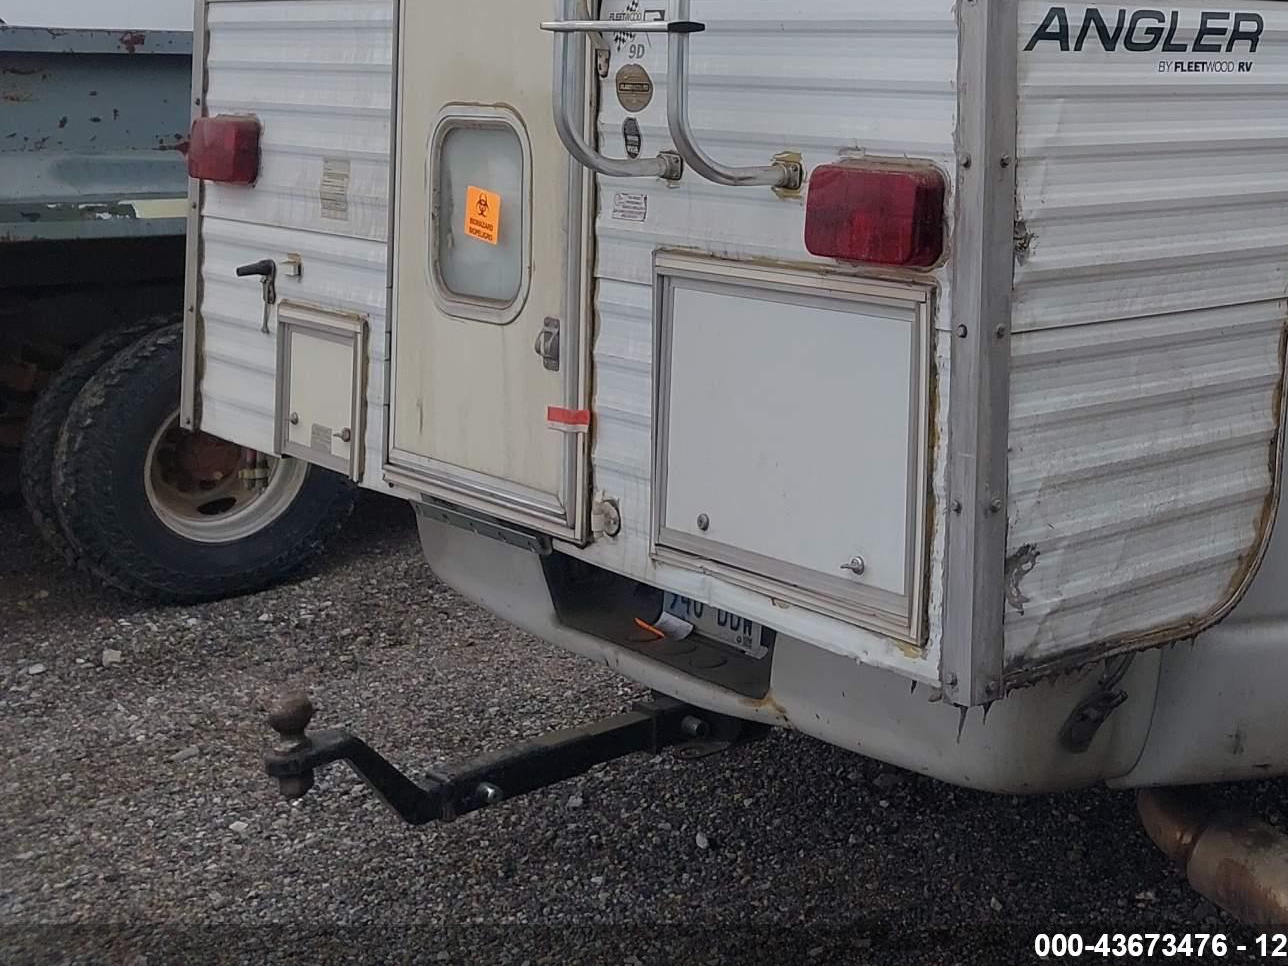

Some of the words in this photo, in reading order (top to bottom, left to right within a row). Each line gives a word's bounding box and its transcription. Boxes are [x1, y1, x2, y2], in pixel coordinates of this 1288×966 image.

[1023, 6, 1265, 54] ANGLER
[1158, 60, 1173, 73] BY
[1174, 60, 1235, 73] FLEETWOOD
[1237, 60, 1254, 73] RV
